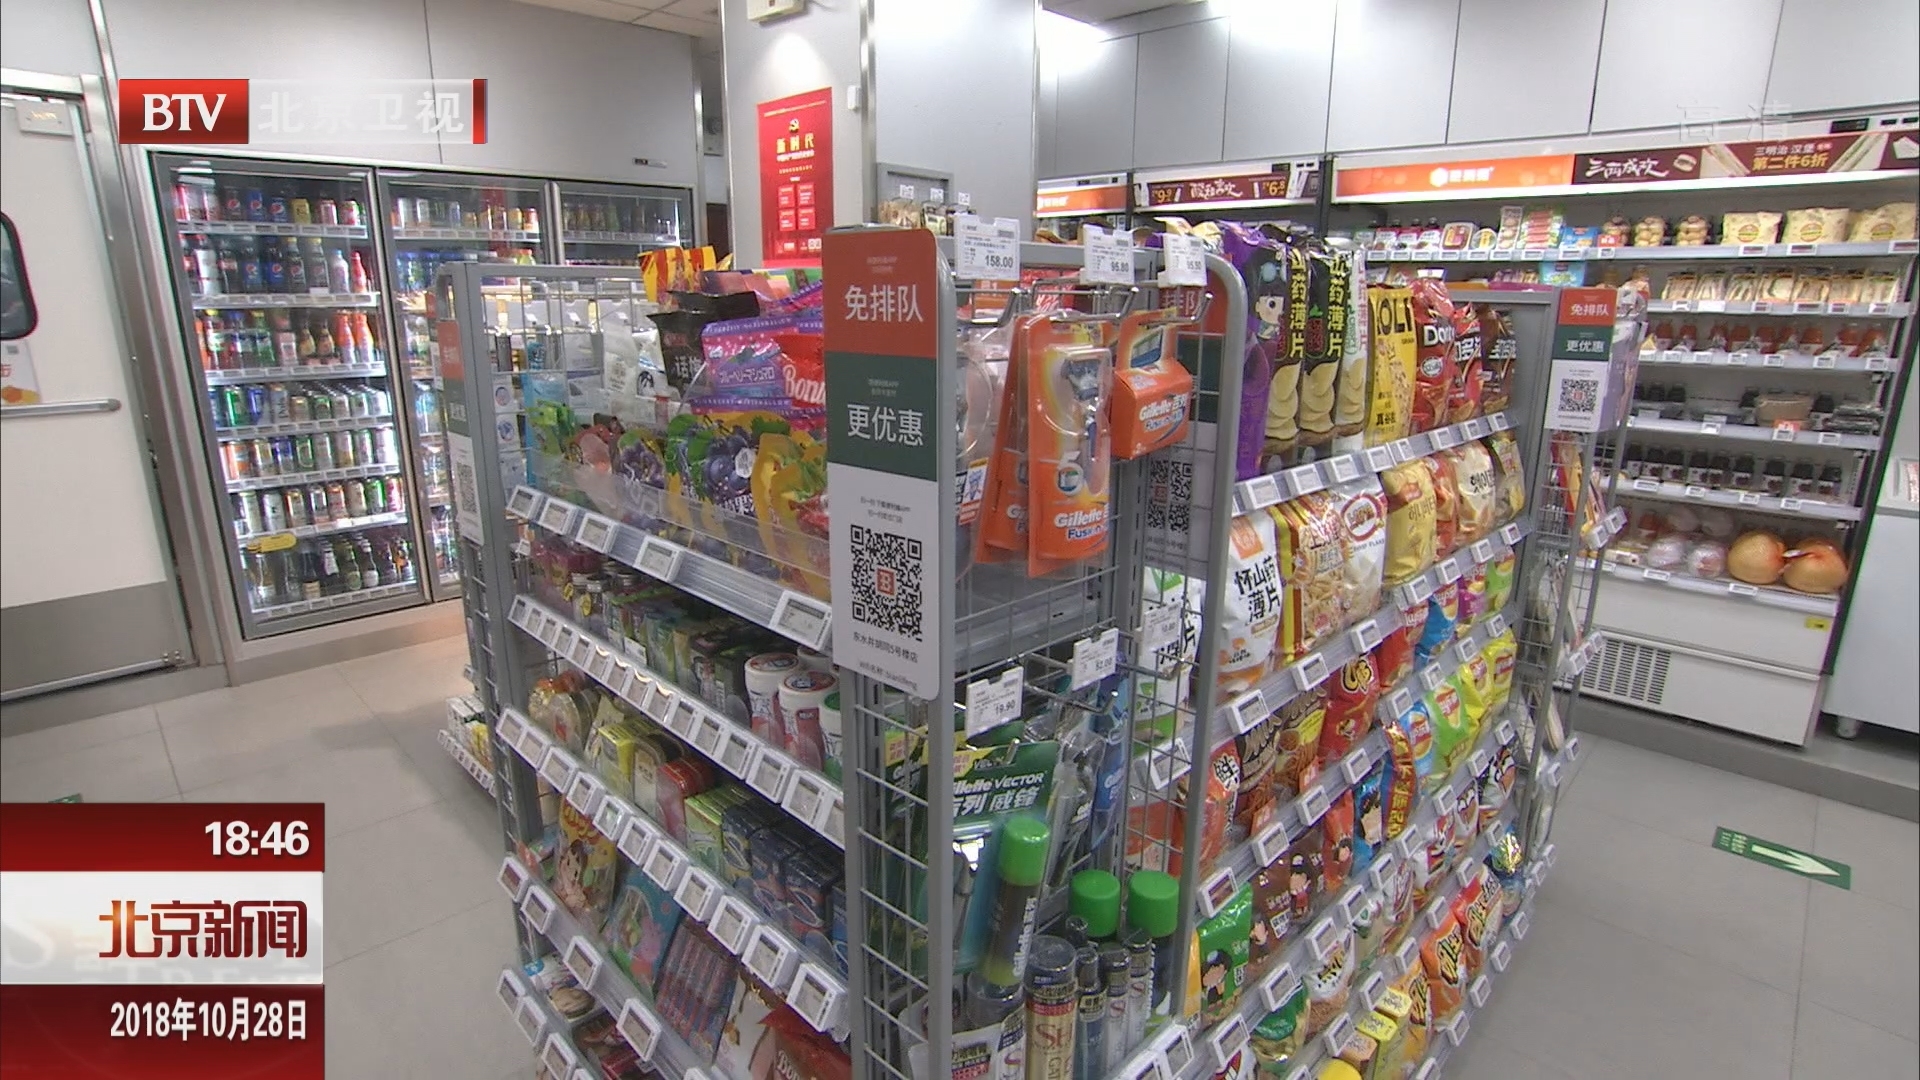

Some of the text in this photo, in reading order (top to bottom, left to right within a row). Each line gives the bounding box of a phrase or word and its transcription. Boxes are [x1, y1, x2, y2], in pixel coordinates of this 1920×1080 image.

[1752, 152, 1829, 171] 第二件6折
[985, 254, 1013, 269] 158.00
[845, 284, 923, 323] 免排队
[1327, 253, 1345, 357] 山药薄片
[1570, 303, 1609, 318] 免排队
[1566, 339, 1605, 353] 更优惠
[847, 404, 923, 446] 更优惠
[1054, 508, 1102, 528] Gillette
[1235, 554, 1277, 596] 怀山药
[994, 772, 1044, 789] VECTOR
